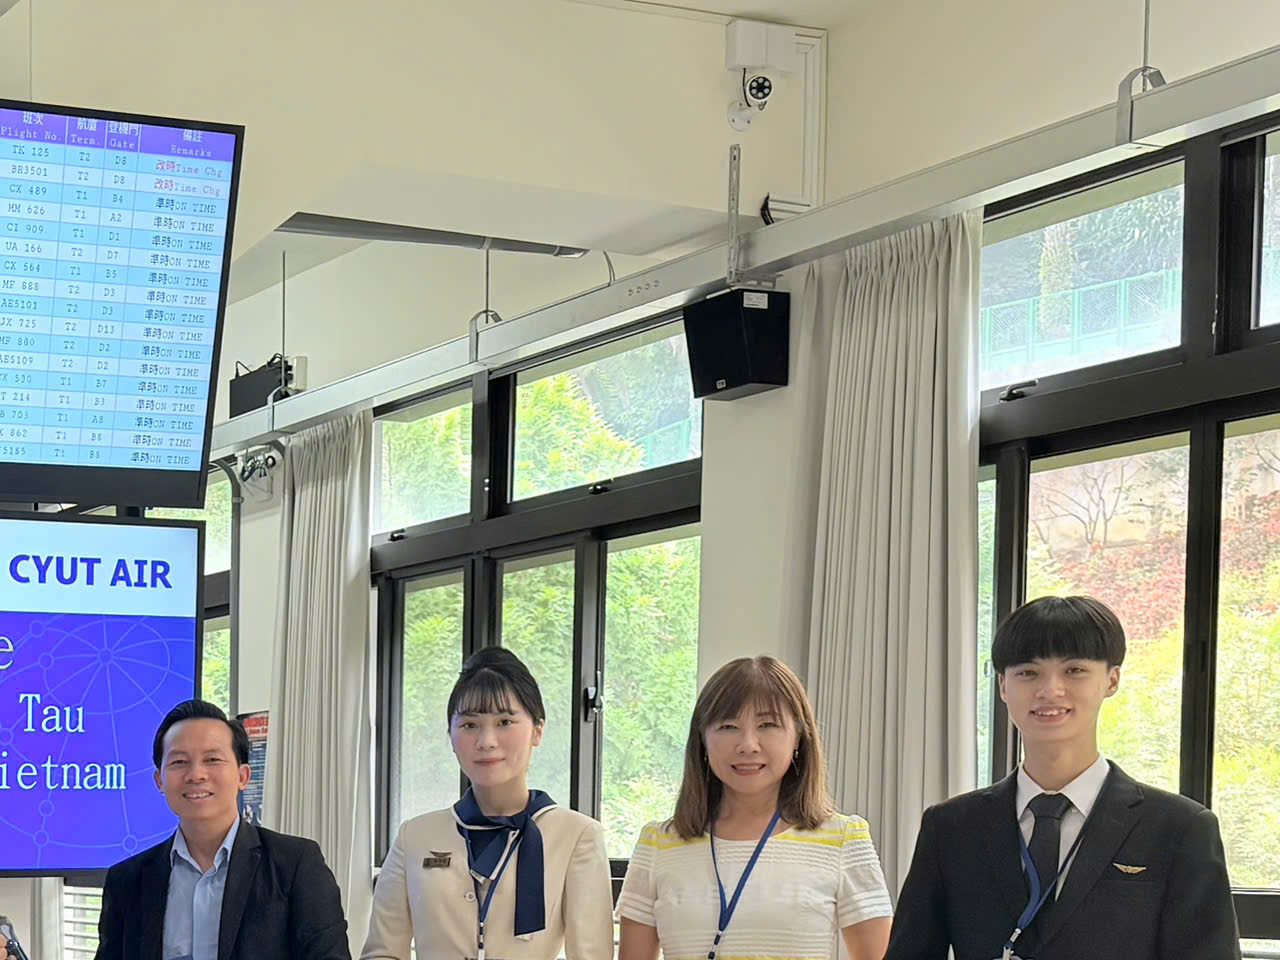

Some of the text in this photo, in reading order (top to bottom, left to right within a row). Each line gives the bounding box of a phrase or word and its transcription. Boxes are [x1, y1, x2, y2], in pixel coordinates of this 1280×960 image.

[0, 126, 38, 140] Flight
[110, 138, 134, 149] Gate
[170, 145, 211, 157] Remarks
[11, 144, 25, 154] TK
[31, 146, 50, 157] 125
[78, 151, 91, 161] T2
[10, 163, 48, 176] BR3501
[77, 170, 89, 181] T2
[8, 183, 22, 193] CX
[28, 185, 47, 196] 489
[75, 190, 88, 200] T1
[192, 203, 216, 213] TIME
[26, 204, 45, 215] 626
[73, 209, 86, 219] T1
[190, 221, 214, 232] TIME
[6, 222, 19, 232] CI
[25, 223, 43, 234] 909
[72, 228, 84, 238] T1
[188, 240, 212, 250] TIME
[4, 241, 17, 251] UA
[23, 242, 42, 253] 166
[70, 247, 83, 257] T2
[186, 258, 210, 269] TIME
[3, 260, 16, 270] CX
[22, 261, 40, 272] 564
[69, 265, 81, 275] T1
[184, 277, 208, 287] TIME
[20, 280, 39, 291] 888
[67, 284, 79, 294] T2
[182, 295, 207, 305] TIME
[65, 303, 78, 312] T2
[180, 313, 205, 323] TIME
[179, 331, 203, 341] TIME
[177, 349, 201, 359] TIME
[175, 367, 199, 377] TIME
[173, 385, 197, 394] TIME
[171, 402, 195, 412] TIME
[9, 554, 172, 589] CYUT AIR
[19, 693, 86, 733] Tau
